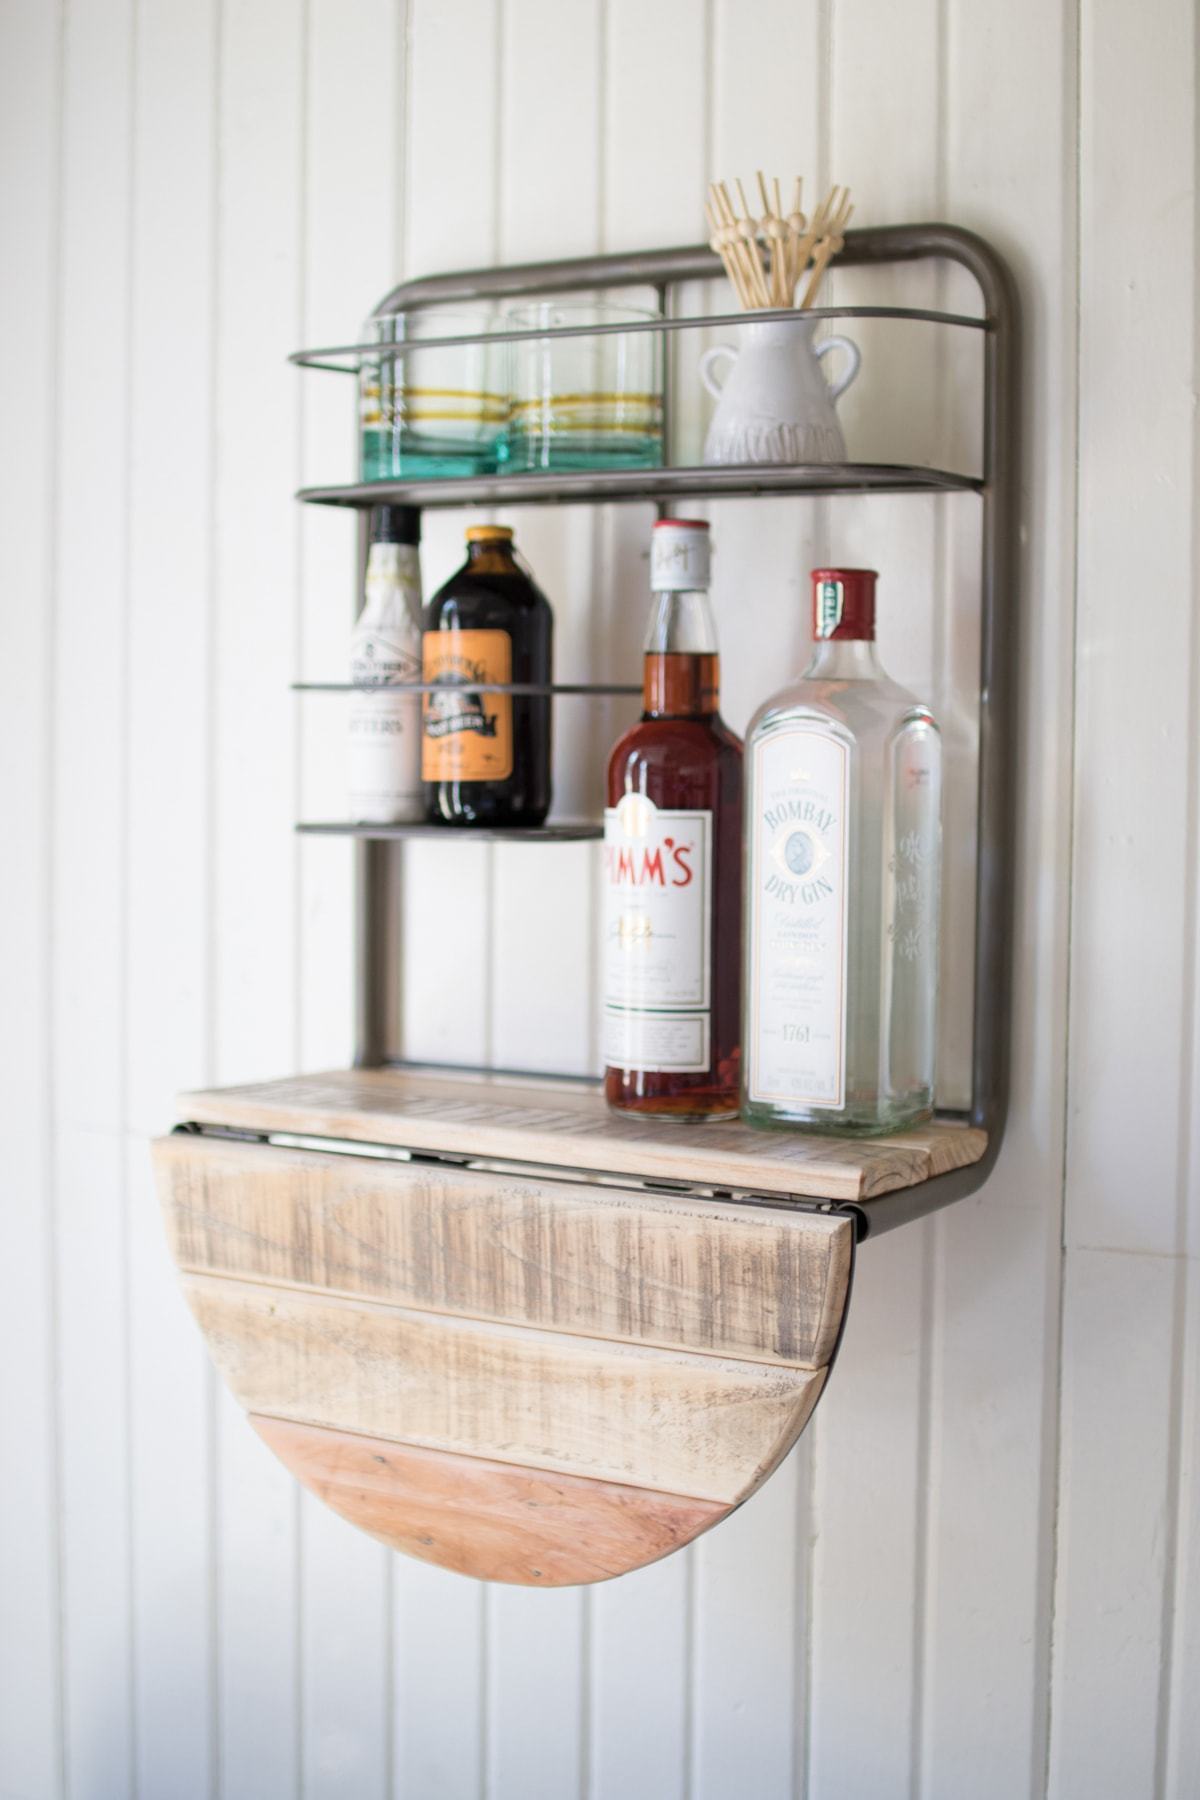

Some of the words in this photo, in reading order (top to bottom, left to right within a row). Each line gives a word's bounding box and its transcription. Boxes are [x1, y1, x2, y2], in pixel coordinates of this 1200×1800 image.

[763, 799, 837, 835] BOMBAY
[764, 874, 797, 904] DRY
[801, 876, 834, 905] GIN
[783, 1024, 810, 1043] 1761
